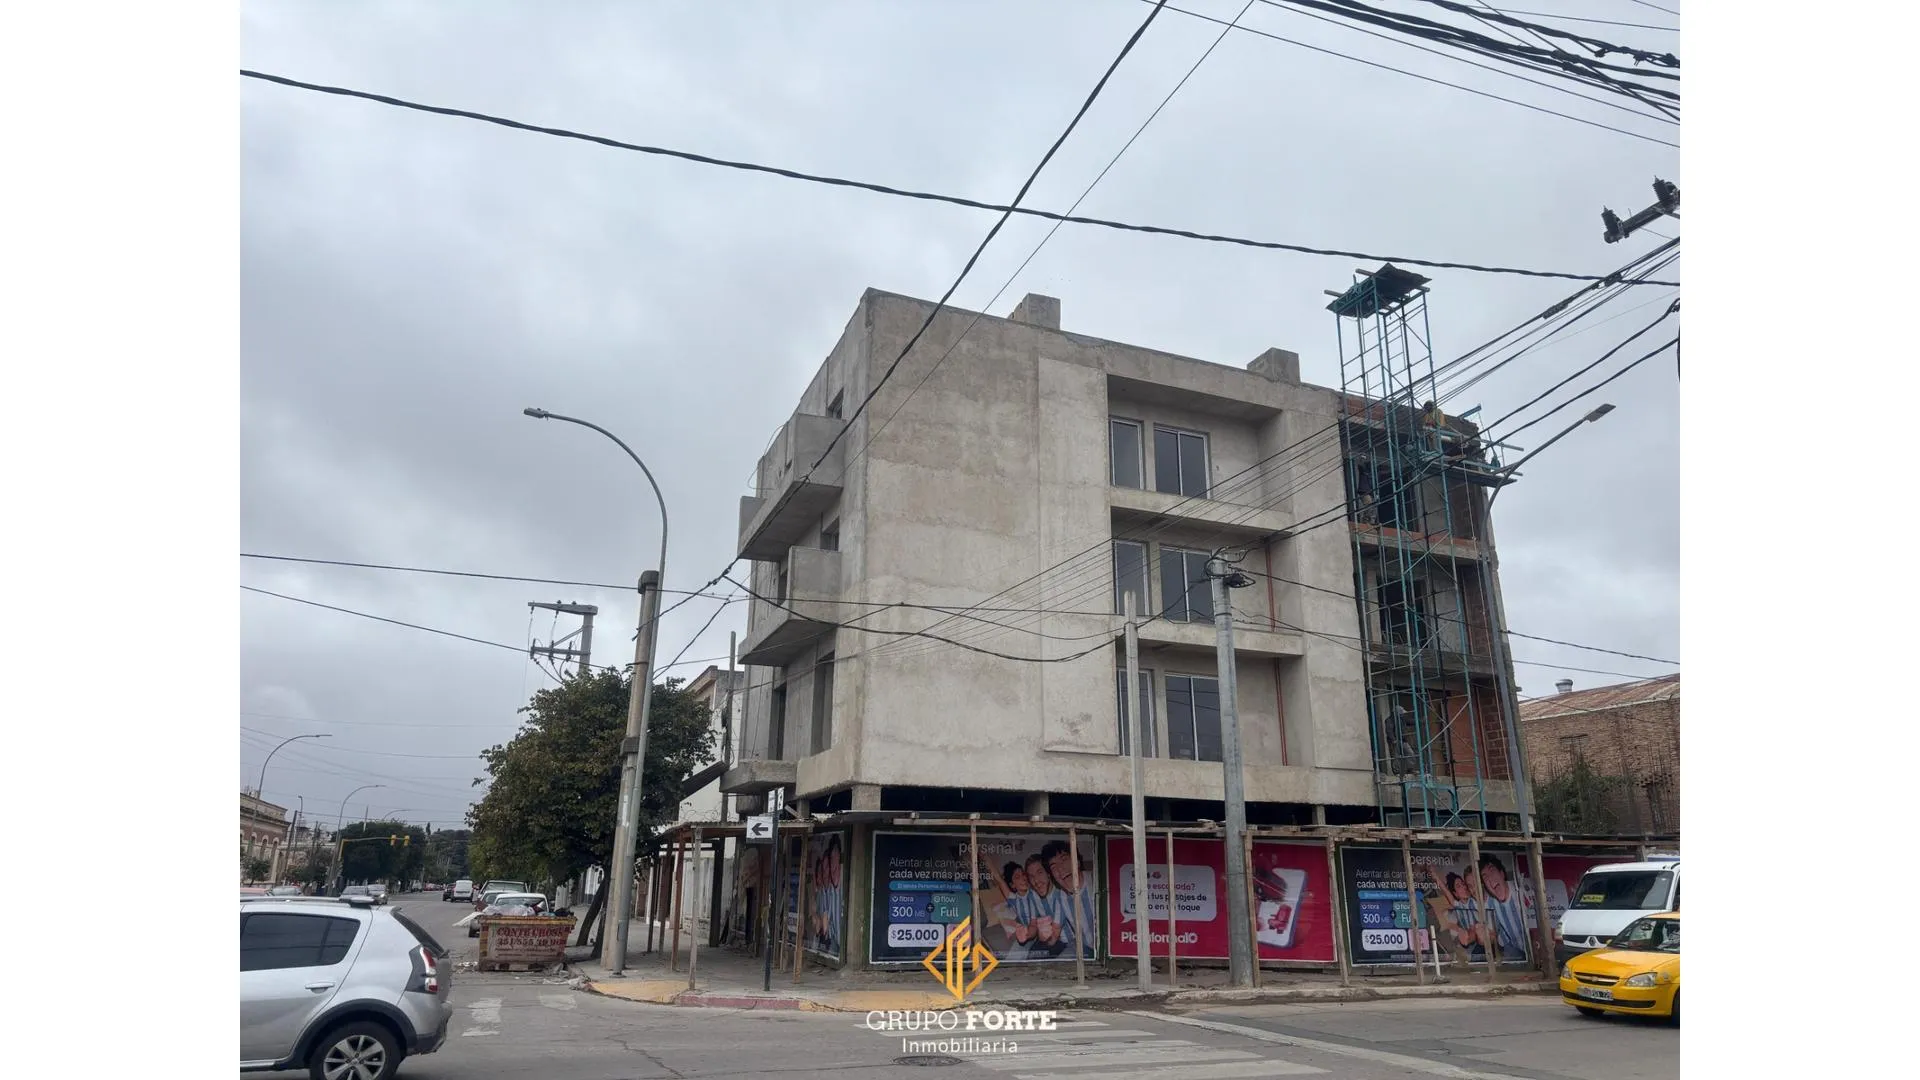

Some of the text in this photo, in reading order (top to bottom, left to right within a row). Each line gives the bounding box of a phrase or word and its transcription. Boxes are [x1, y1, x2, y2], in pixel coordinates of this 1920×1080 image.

[889, 858, 924, 868] Alentar
[889, 869, 912, 879] cada
[915, 870, 930, 879] vez
[932, 869, 953, 879] más
[1356, 869, 1382, 879] Alentar
[1356, 880, 1375, 889] cada
[1376, 881, 1389, 889] vez
[1390, 880, 1407, 889] más
[1197, 893, 1207, 901] de
[892, 906, 913, 917] 300
[940, 906, 959, 917] Full
[1178, 903, 1200, 912] toque
[1363, 913, 1380, 923] 300
[891, 929, 939, 941] $25.000
[1364, 934, 1403, 945] $25.000
